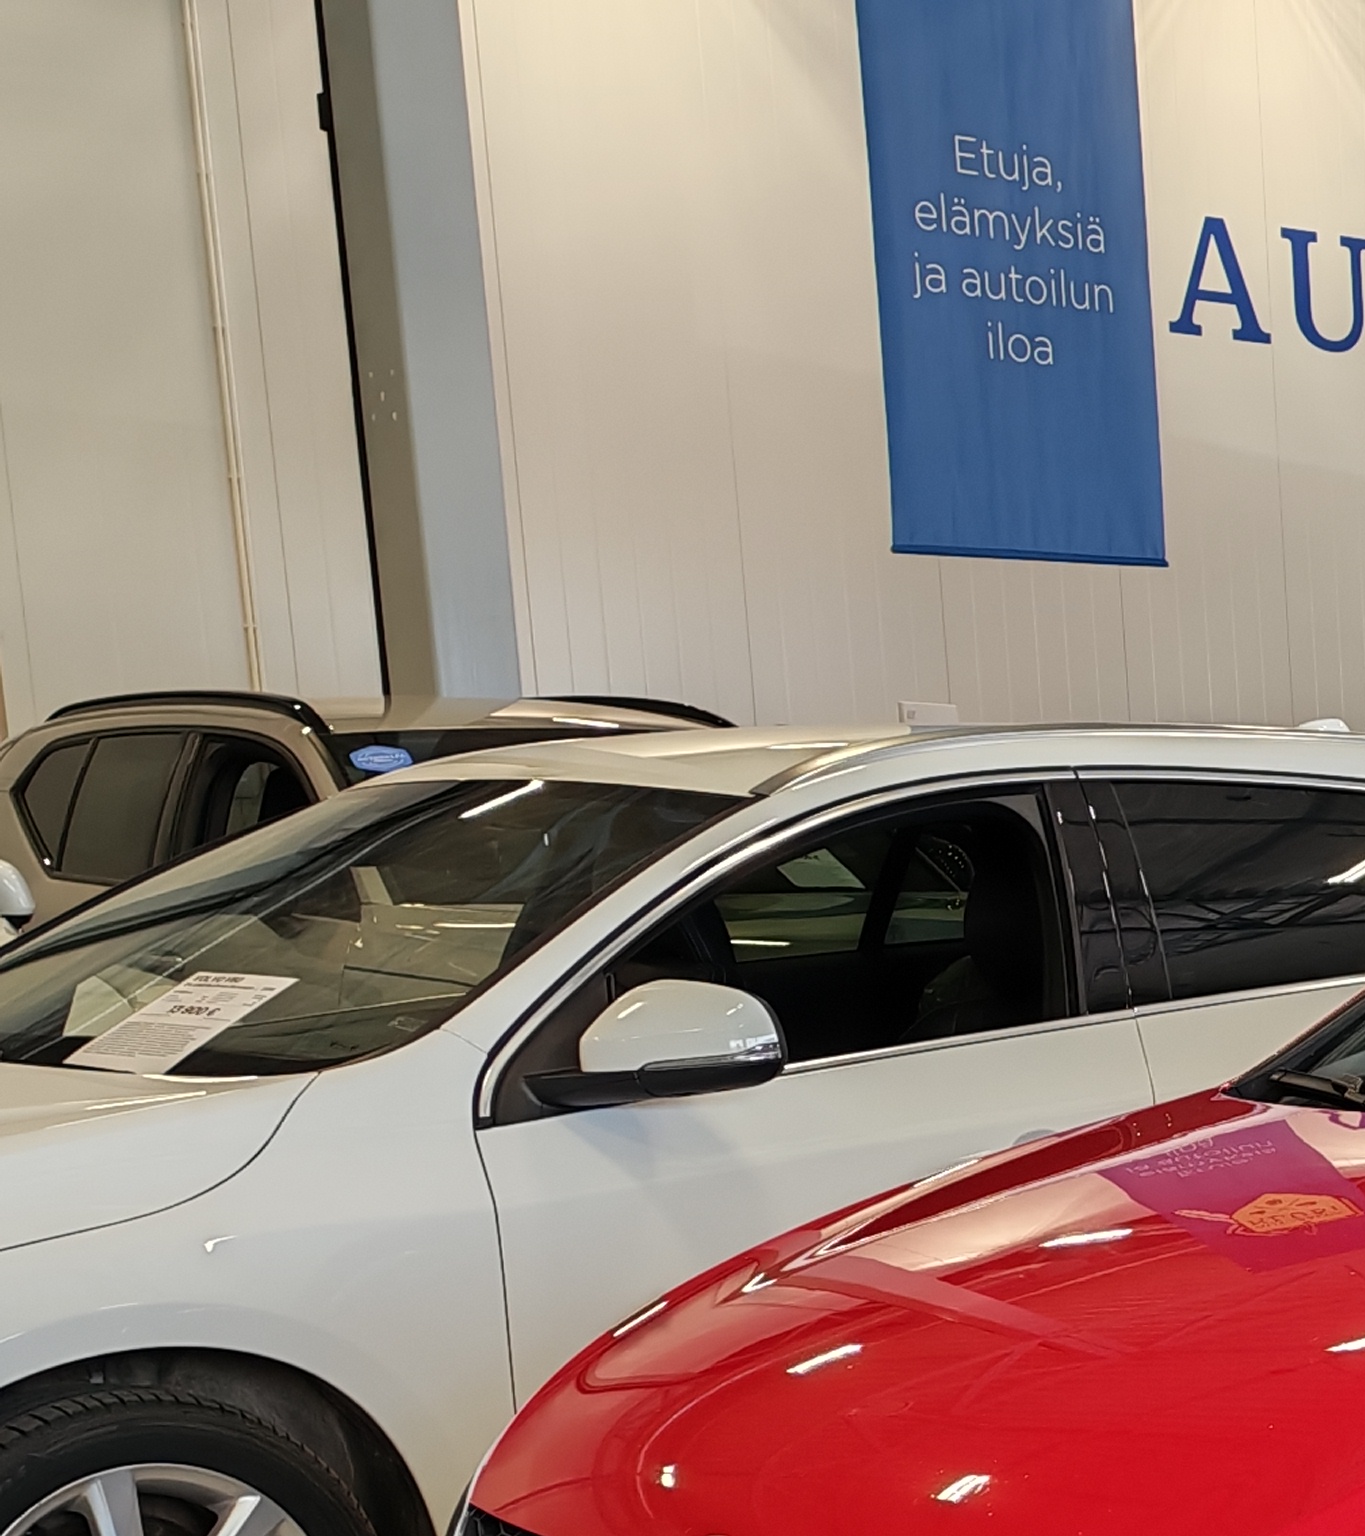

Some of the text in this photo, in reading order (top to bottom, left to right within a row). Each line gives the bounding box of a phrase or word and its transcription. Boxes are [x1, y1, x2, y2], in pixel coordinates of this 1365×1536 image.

[954, 134, 1063, 193] Etuja,
[914, 192, 1105, 254] elämyksiä
[913, 252, 1114, 313] ja autoilun
[987, 320, 1054, 365] iloa
